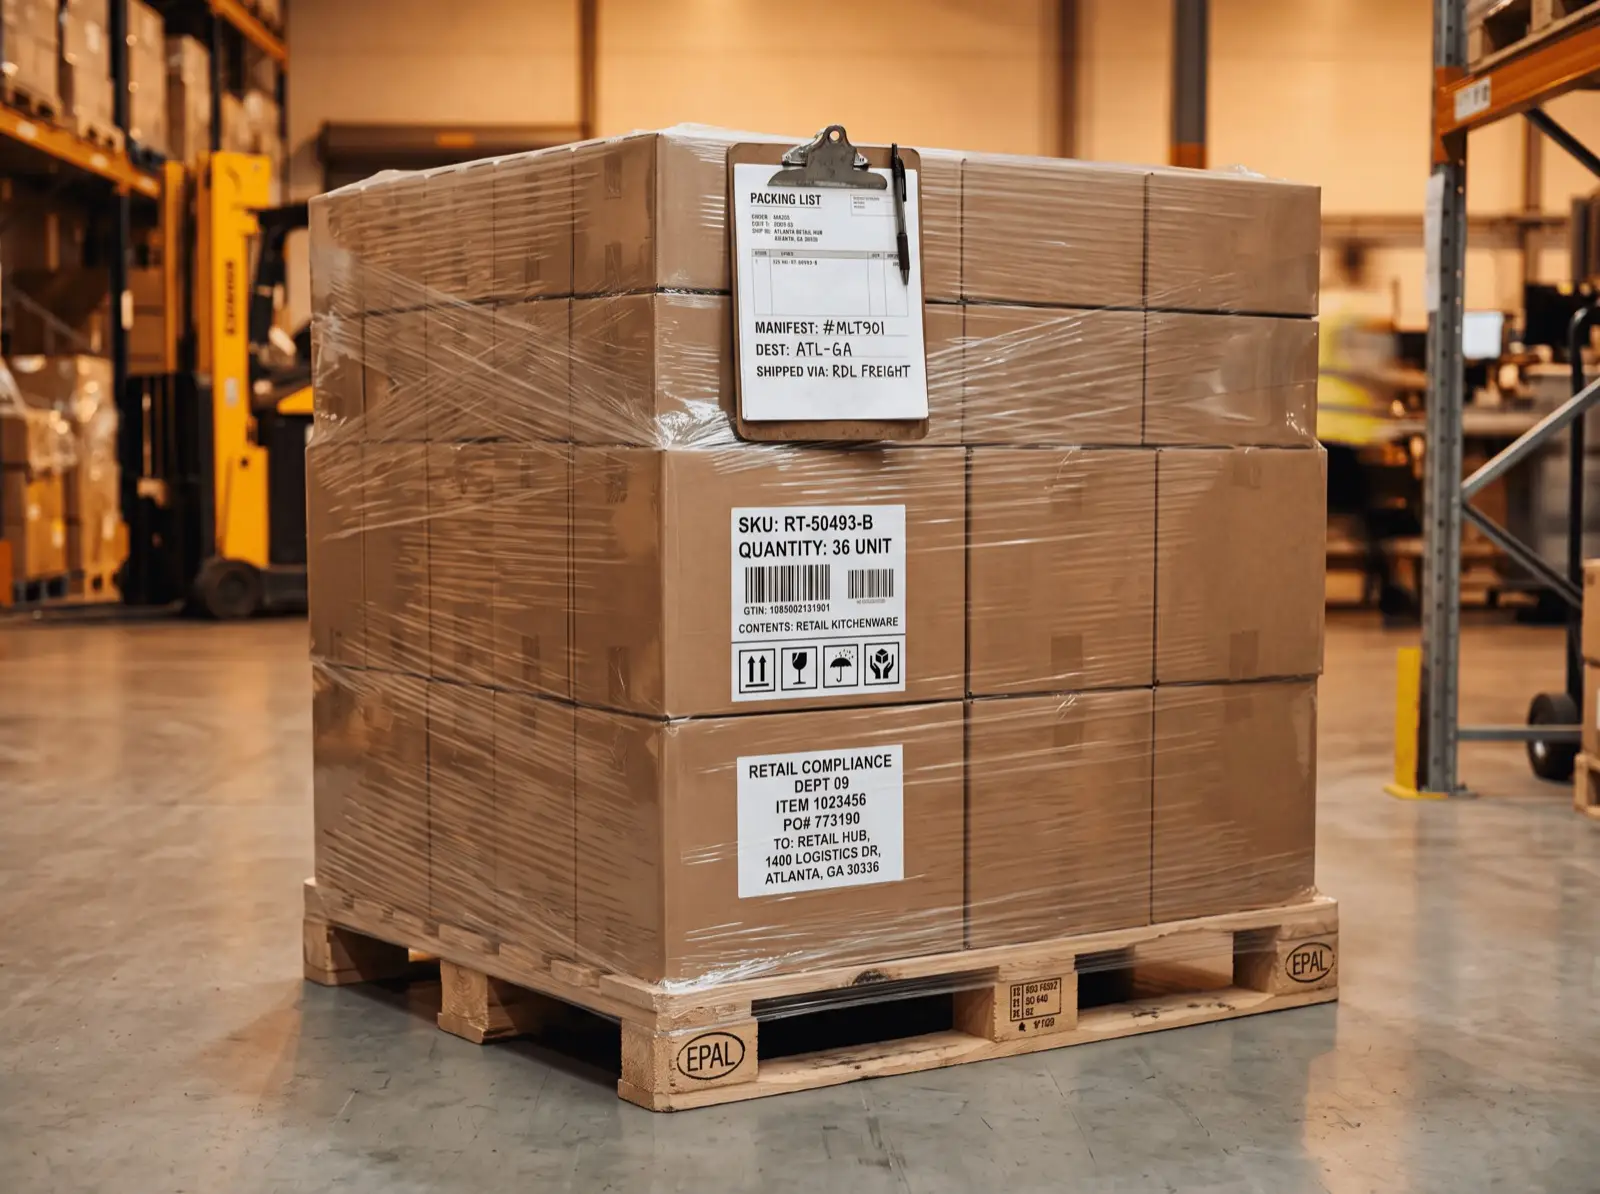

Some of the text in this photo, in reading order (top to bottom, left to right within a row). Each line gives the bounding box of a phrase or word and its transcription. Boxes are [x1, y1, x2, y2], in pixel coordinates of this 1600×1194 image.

[750, 192, 821, 205] PACKING LIST
[755, 322, 818, 334] MANIFEST:
[756, 342, 852, 356] DEST: ATL-GA
[757, 365, 911, 378] SHIPPED VIA: RDL FREIGHT
[738, 514, 873, 533] SKU: RT-50493-B
[739, 538, 892, 558] QUANTITY: 36 UNIT
[743, 604, 830, 615] GTIN: 1085002131901
[739, 617, 898, 633] CONTENTS: RETAIL KITCHENWARE
[749, 754, 892, 778] RETAIL COMPLIANCE
[795, 776, 849, 793] DEPT 09
[776, 793, 866, 814] ITEM 1023456
[784, 812, 860, 831] PO# 773190
[774, 830, 870, 850] TO: RETAIL HUB,
[766, 845, 881, 868] 1400 LOGISTICS DR,
[765, 861, 879, 885] ATLANTA, GA 30336
[1293, 950, 1328, 975] EPAL
[687, 1041, 735, 1071] EPAL
